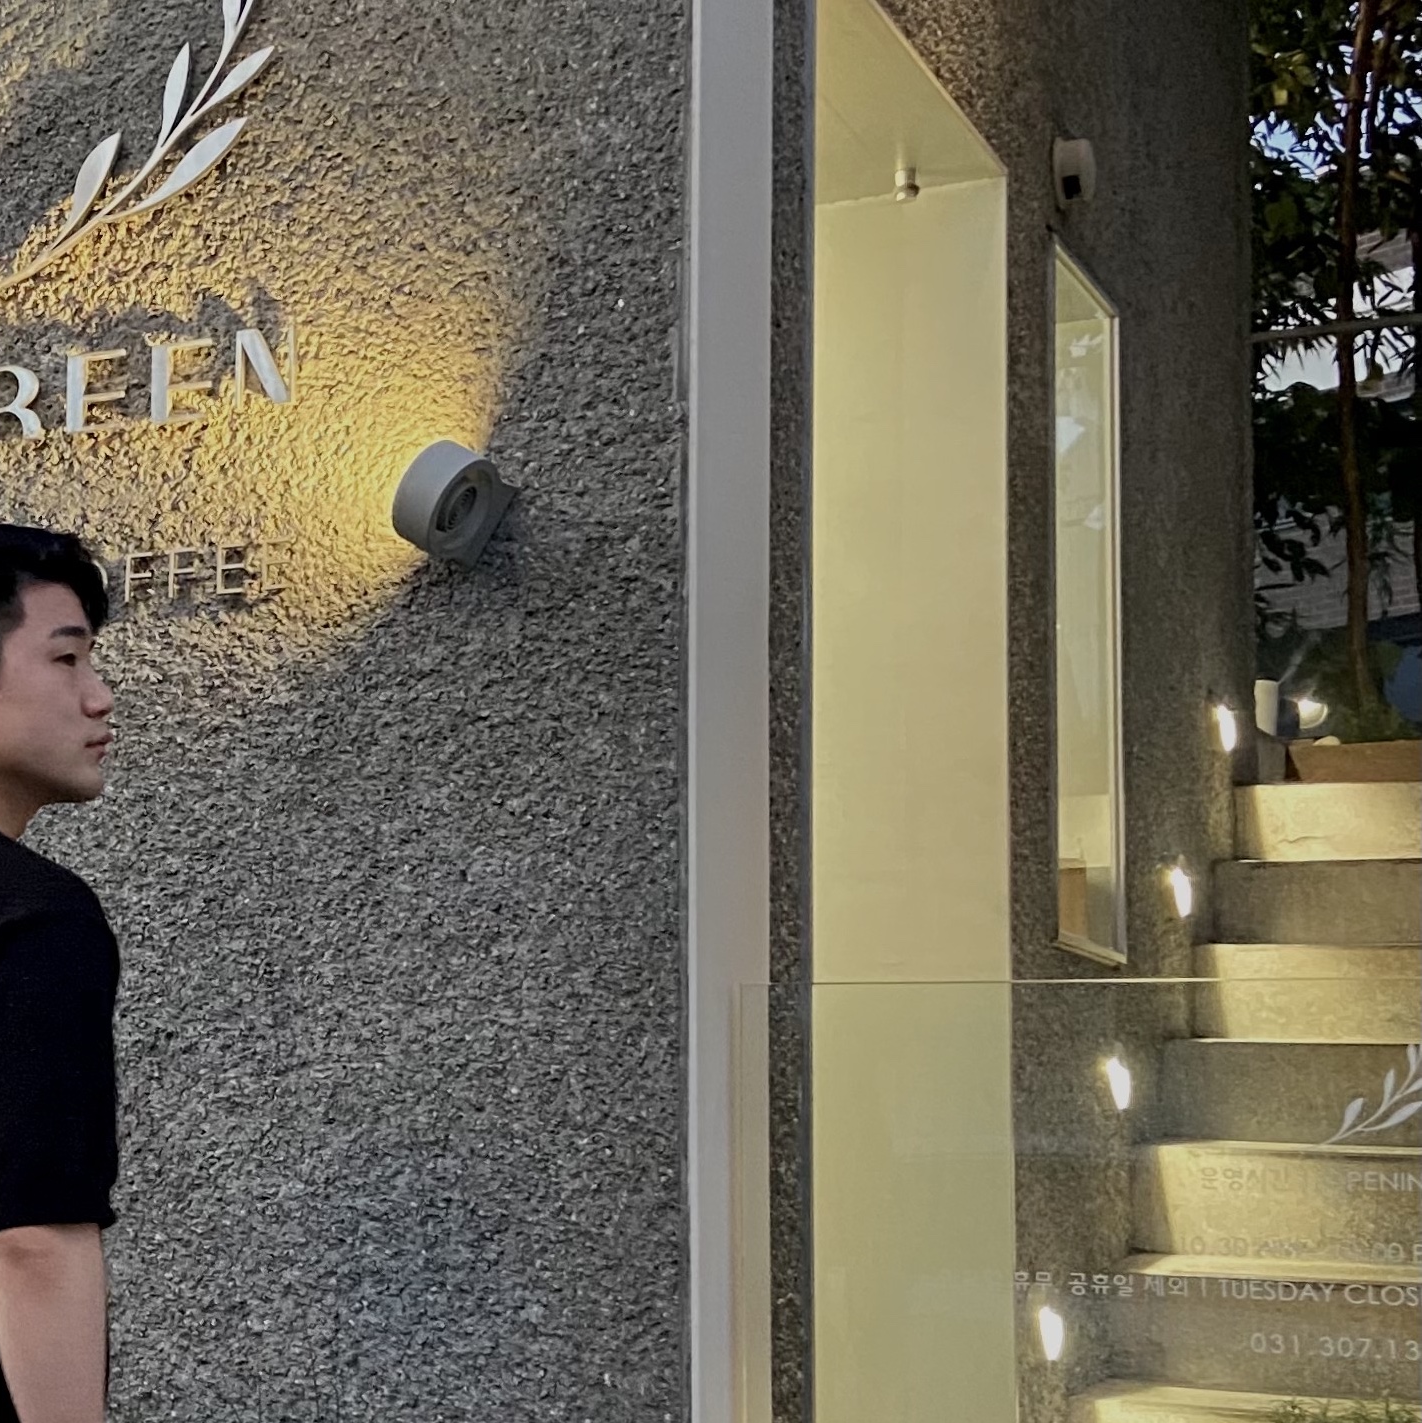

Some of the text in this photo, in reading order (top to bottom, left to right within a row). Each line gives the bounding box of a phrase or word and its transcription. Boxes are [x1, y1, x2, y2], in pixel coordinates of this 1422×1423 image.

[91, 535, 295, 602] FFEE
[1346, 1170, 1422, 1192] PENIN
[1069, 1272, 1134, 1296] 공휴일
[1144, 1274, 1189, 1297] 제외
[1218, 1279, 1335, 1302] TUESDAY
